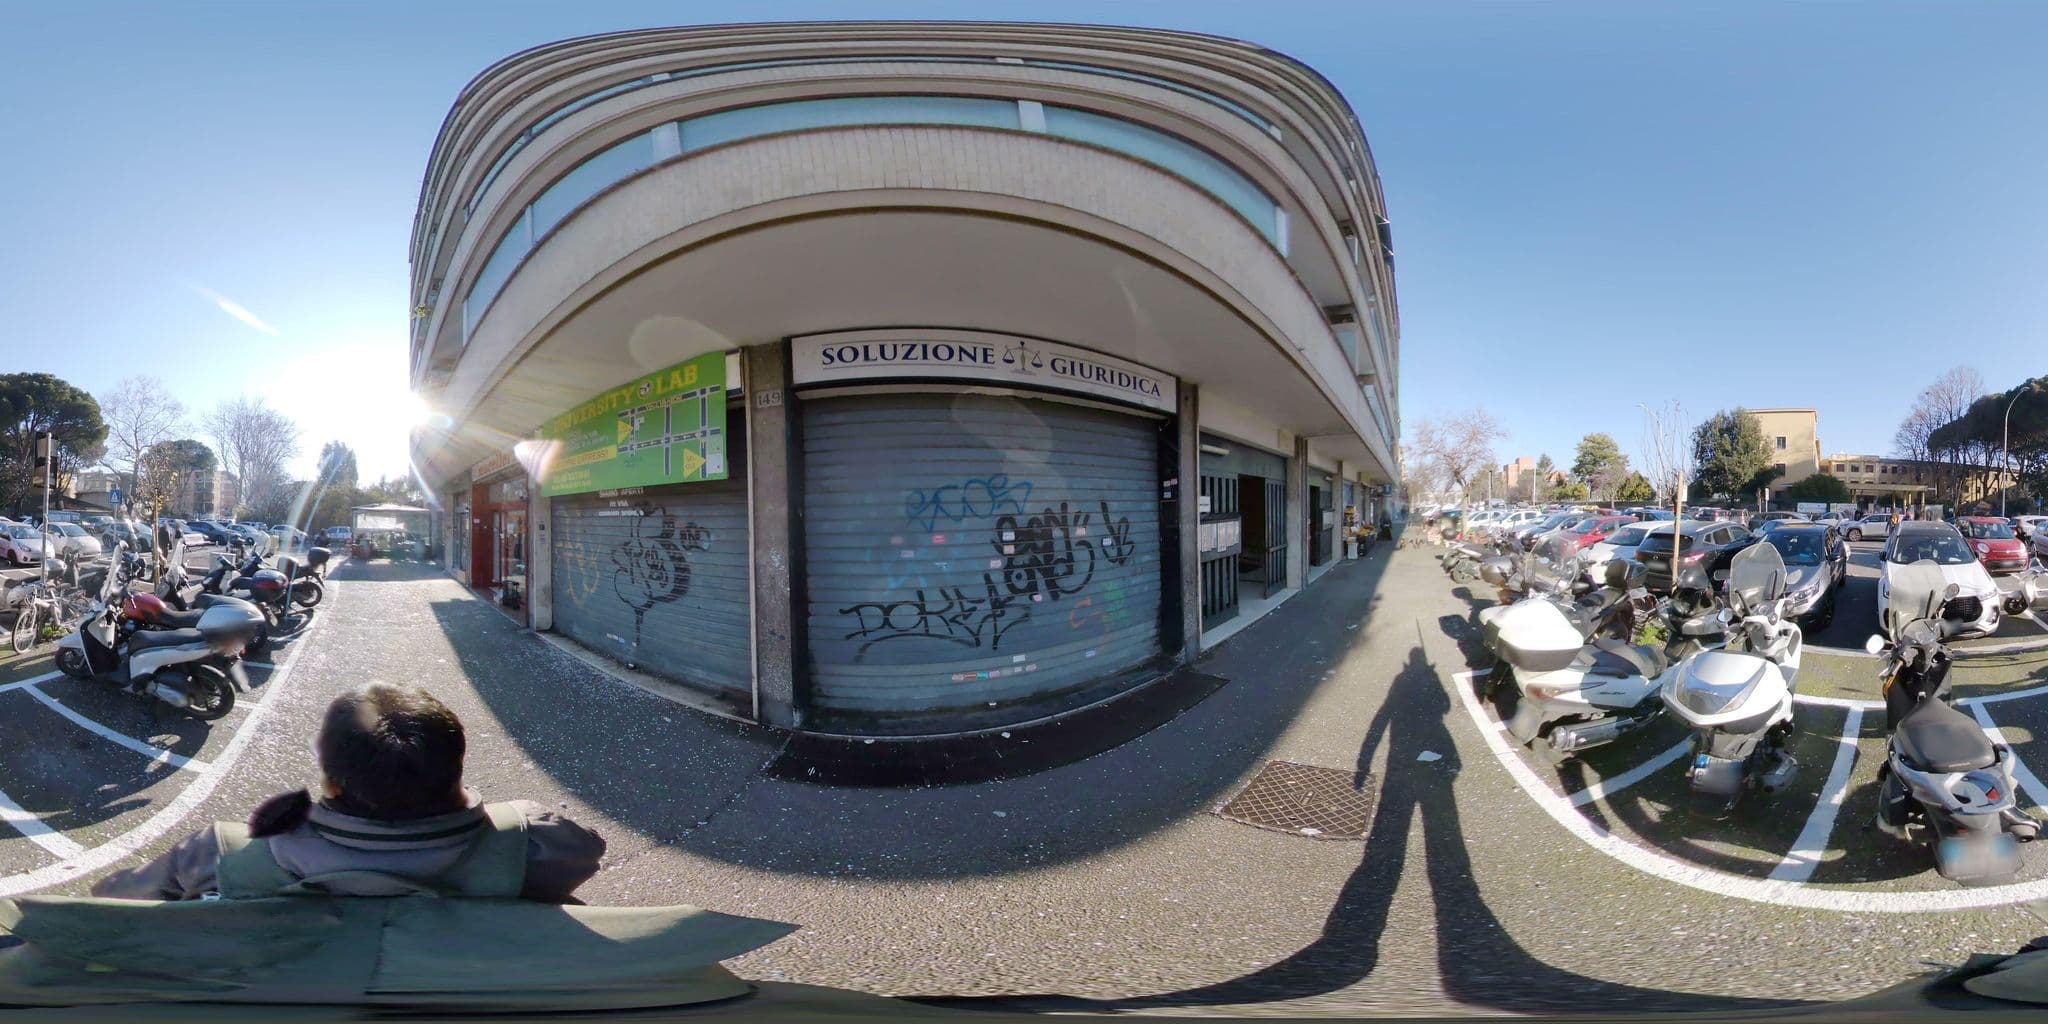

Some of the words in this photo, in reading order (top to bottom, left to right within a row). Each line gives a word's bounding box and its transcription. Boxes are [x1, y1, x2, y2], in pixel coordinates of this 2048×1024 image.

[656, 364, 699, 396] LAB
[821, 342, 996, 366] SOLUZIONE
[1049, 355, 1162, 398] GIURIDICA
[758, 391, 781, 405] 149
